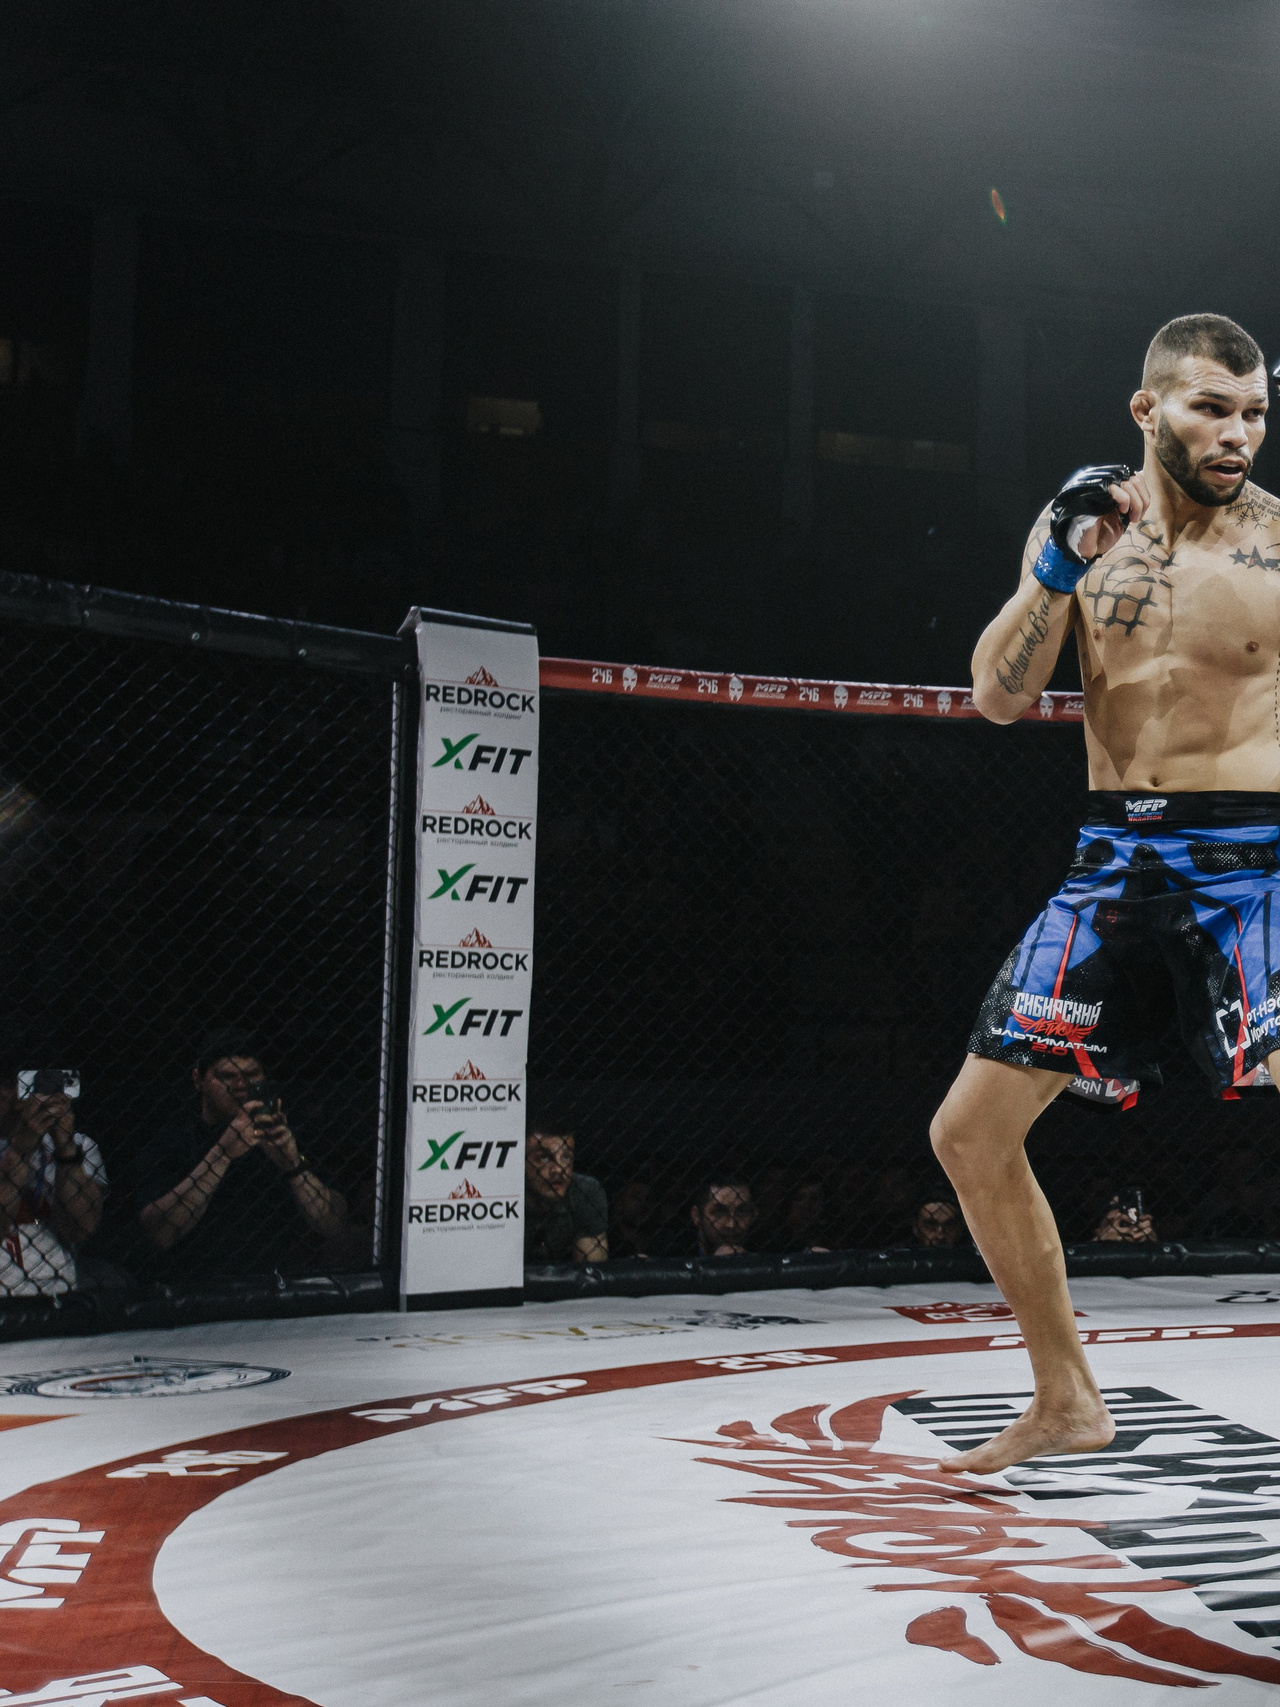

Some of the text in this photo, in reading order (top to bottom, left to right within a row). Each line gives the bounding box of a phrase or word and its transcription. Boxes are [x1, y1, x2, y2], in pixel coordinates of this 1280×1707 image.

[425, 684, 535, 713] REDROCK
[592, 667, 613, 684] 246
[698, 679, 719, 695] 246
[799, 687, 820, 702] 246
[902, 693, 924, 709] 246
[1125, 799, 1168, 812] MFP
[422, 815, 532, 841] REDROCK
[419, 950, 529, 971] REDROCK
[991, 1027, 1107, 1053] УЛЬТИМАТУМ
[1032, 1042, 1068, 1056] 2.0
[412, 1084, 522, 1103] REDROCK
[409, 1201, 519, 1224] REDROCK
[349, 1378, 589, 1423] MFP
[695, 1351, 839, 1371] 246
